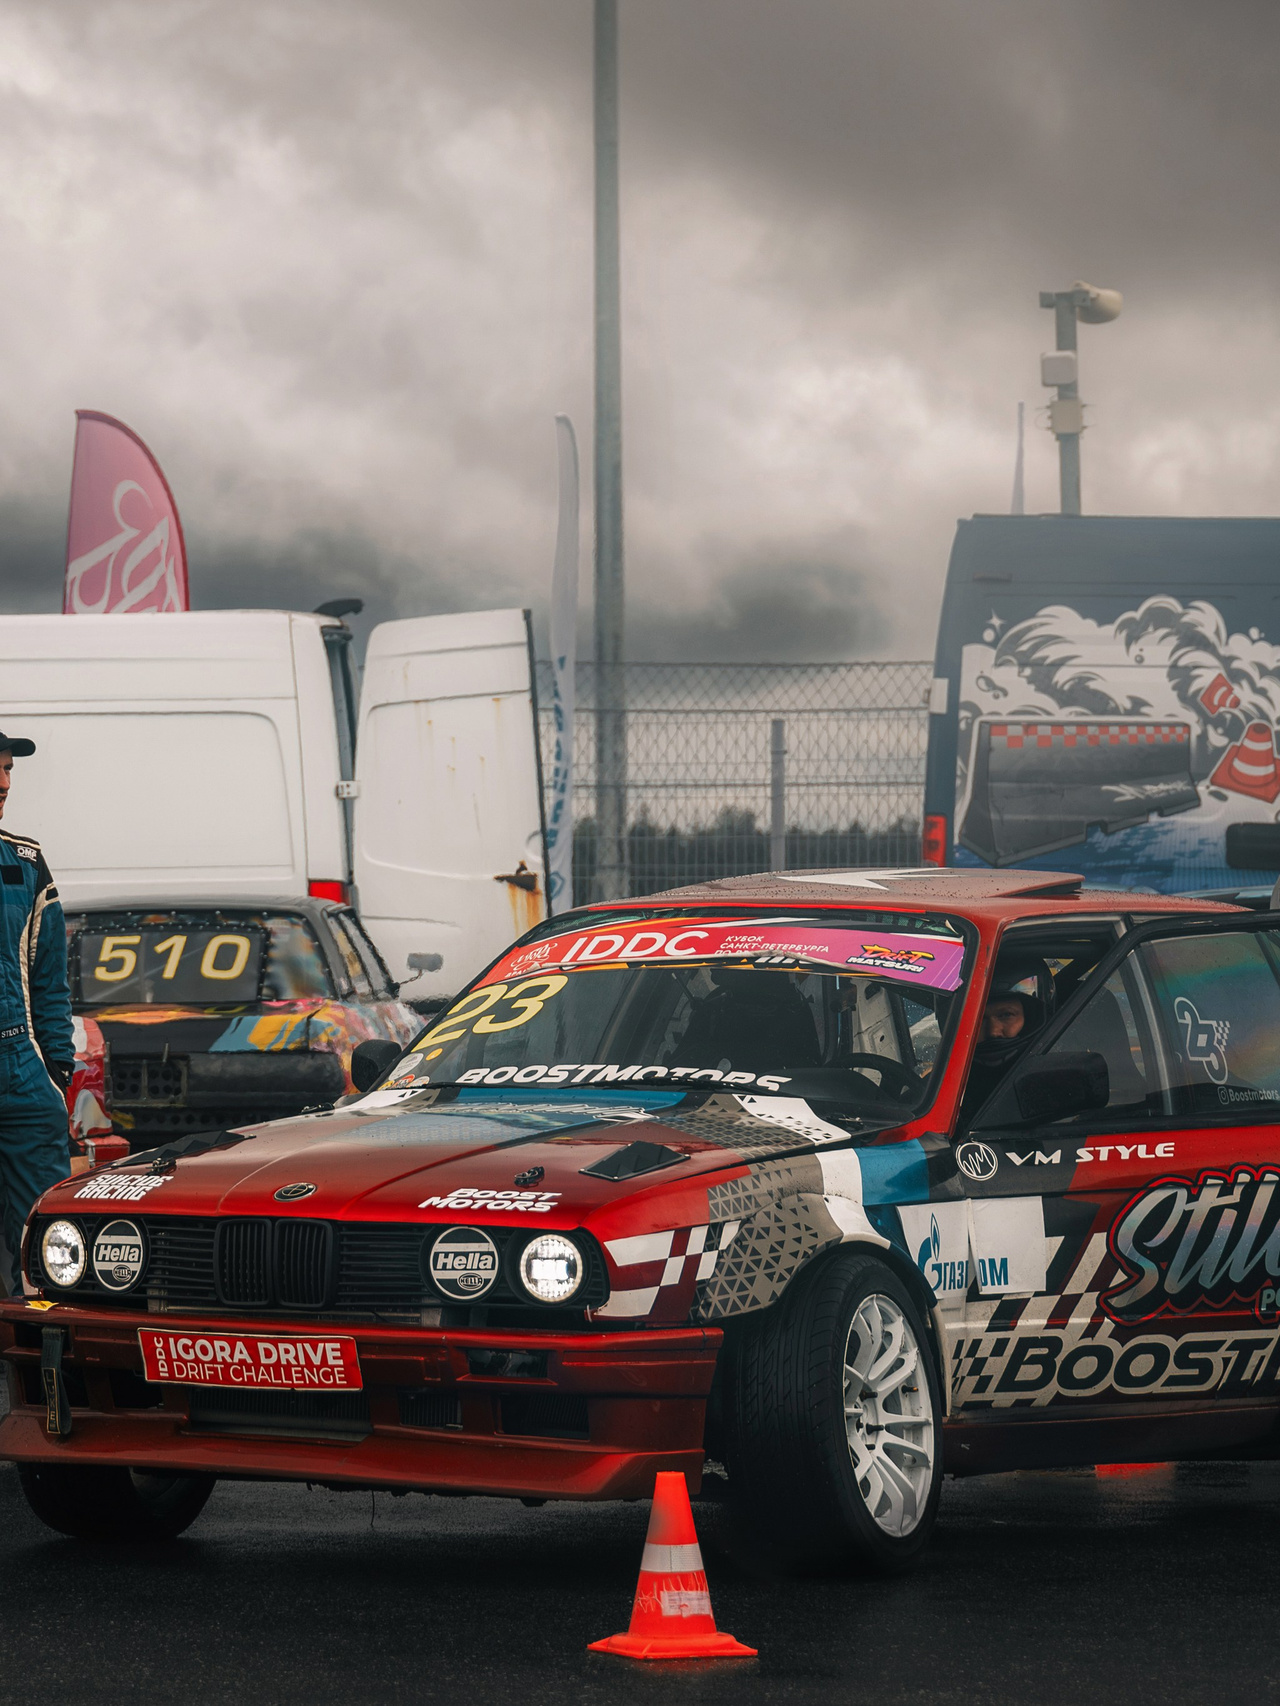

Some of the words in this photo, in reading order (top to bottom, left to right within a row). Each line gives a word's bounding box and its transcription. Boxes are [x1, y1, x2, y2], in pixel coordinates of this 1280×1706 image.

[561, 930, 709, 963] IDDC
[720, 943, 829, 953] САНКТ-ПЕТЕРБУРГА
[94, 934, 251, 982] 510
[846, 956, 926, 973] MATSURI
[411, 975, 568, 1053] 23
[455, 1064, 792, 1092] BOOSTMOTORS
[1228, 1088, 1280, 1101] Boostmotors
[1005, 1150, 1062, 1166] VM
[1075, 1142, 1175, 1164] STYLE
[86, 1174, 174, 1187] SUICIDE
[73, 1184, 154, 1200] RACING
[447, 1188, 562, 1201] BOOST
[418, 1196, 558, 1213] MOTORS
[98, 1244, 140, 1261] Hella
[436, 1252, 494, 1270] Hella
[942, 1257, 1009, 1291] ГАЗОМ
[153, 1336, 169, 1377] IDDC
[169, 1337, 253, 1364] IGORA
[257, 1342, 344, 1366] DRIVE
[173, 1361, 224, 1382] DRIFT
[229, 1364, 347, 1385] CHALLENGE
